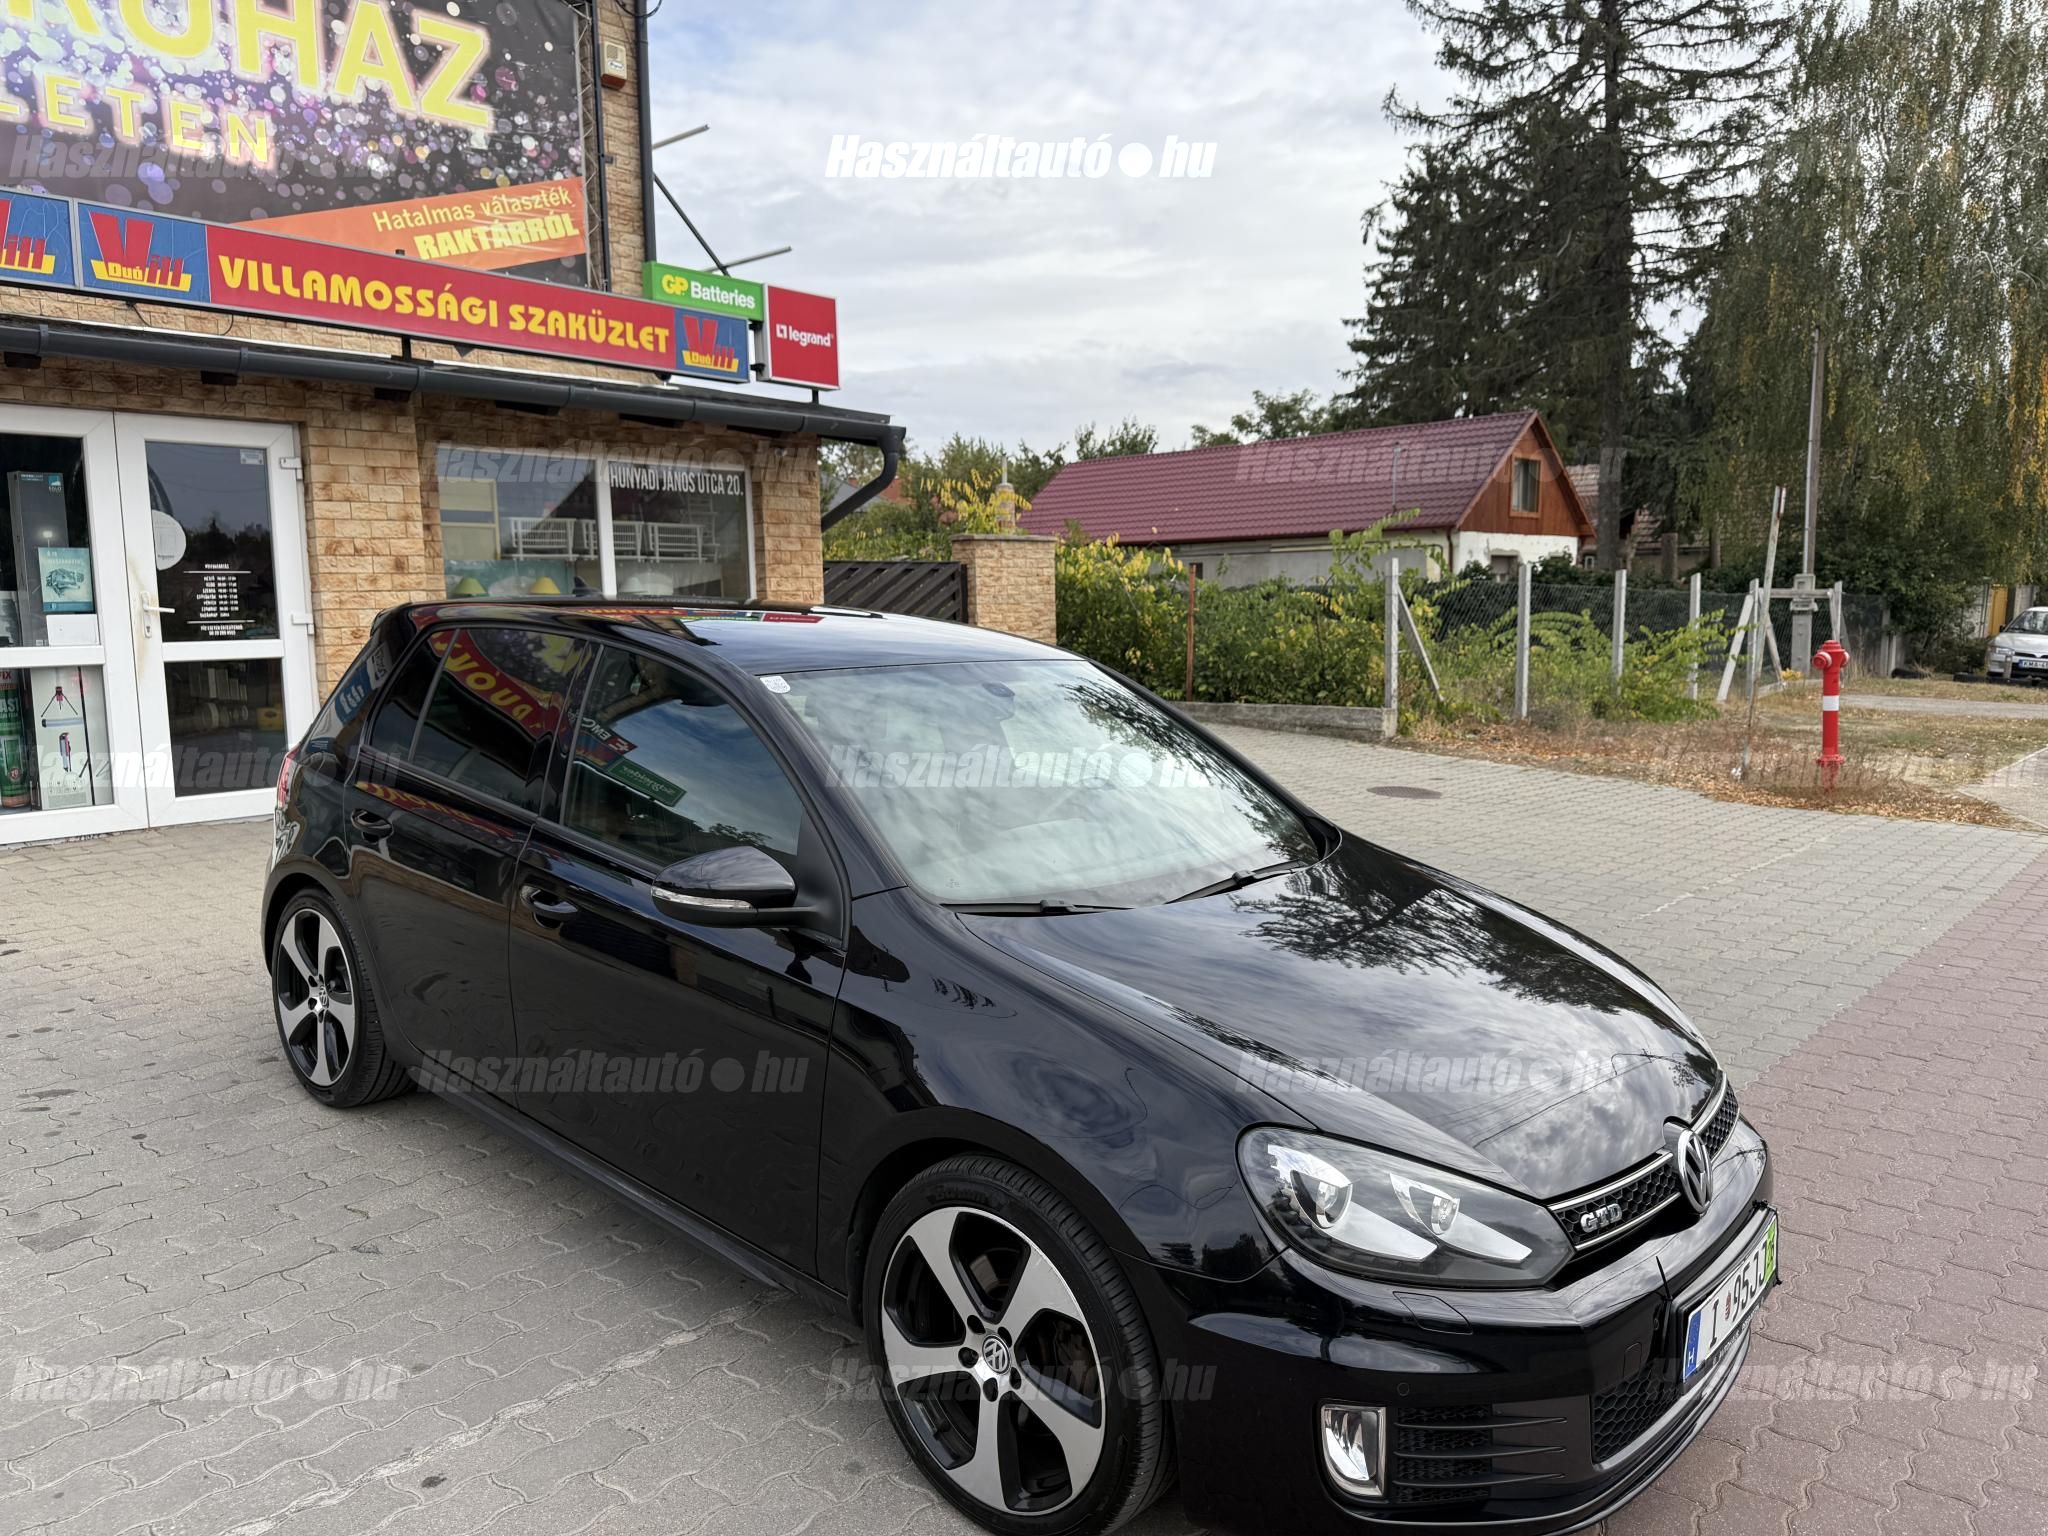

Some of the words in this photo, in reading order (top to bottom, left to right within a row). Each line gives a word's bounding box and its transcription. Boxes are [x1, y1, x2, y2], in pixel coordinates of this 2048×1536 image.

[372, 204, 476, 232] Hatalmas
[480, 186, 574, 217] választék
[414, 210, 580, 260] RAKTÁRRÓL
[218, 255, 499, 328] VILLAMOSSÁGI
[508, 303, 670, 353] SZAKÜZLET
[690, 280, 756, 310] Batteries
[788, 324, 832, 348] legrand
[610, 466, 660, 489] HUNYADI
[662, 467, 696, 493] JÁNOS
[697, 471, 725, 495] UTCA
[727, 474, 744, 496] 20.
[1580, 1203, 1623, 1233] GTD
